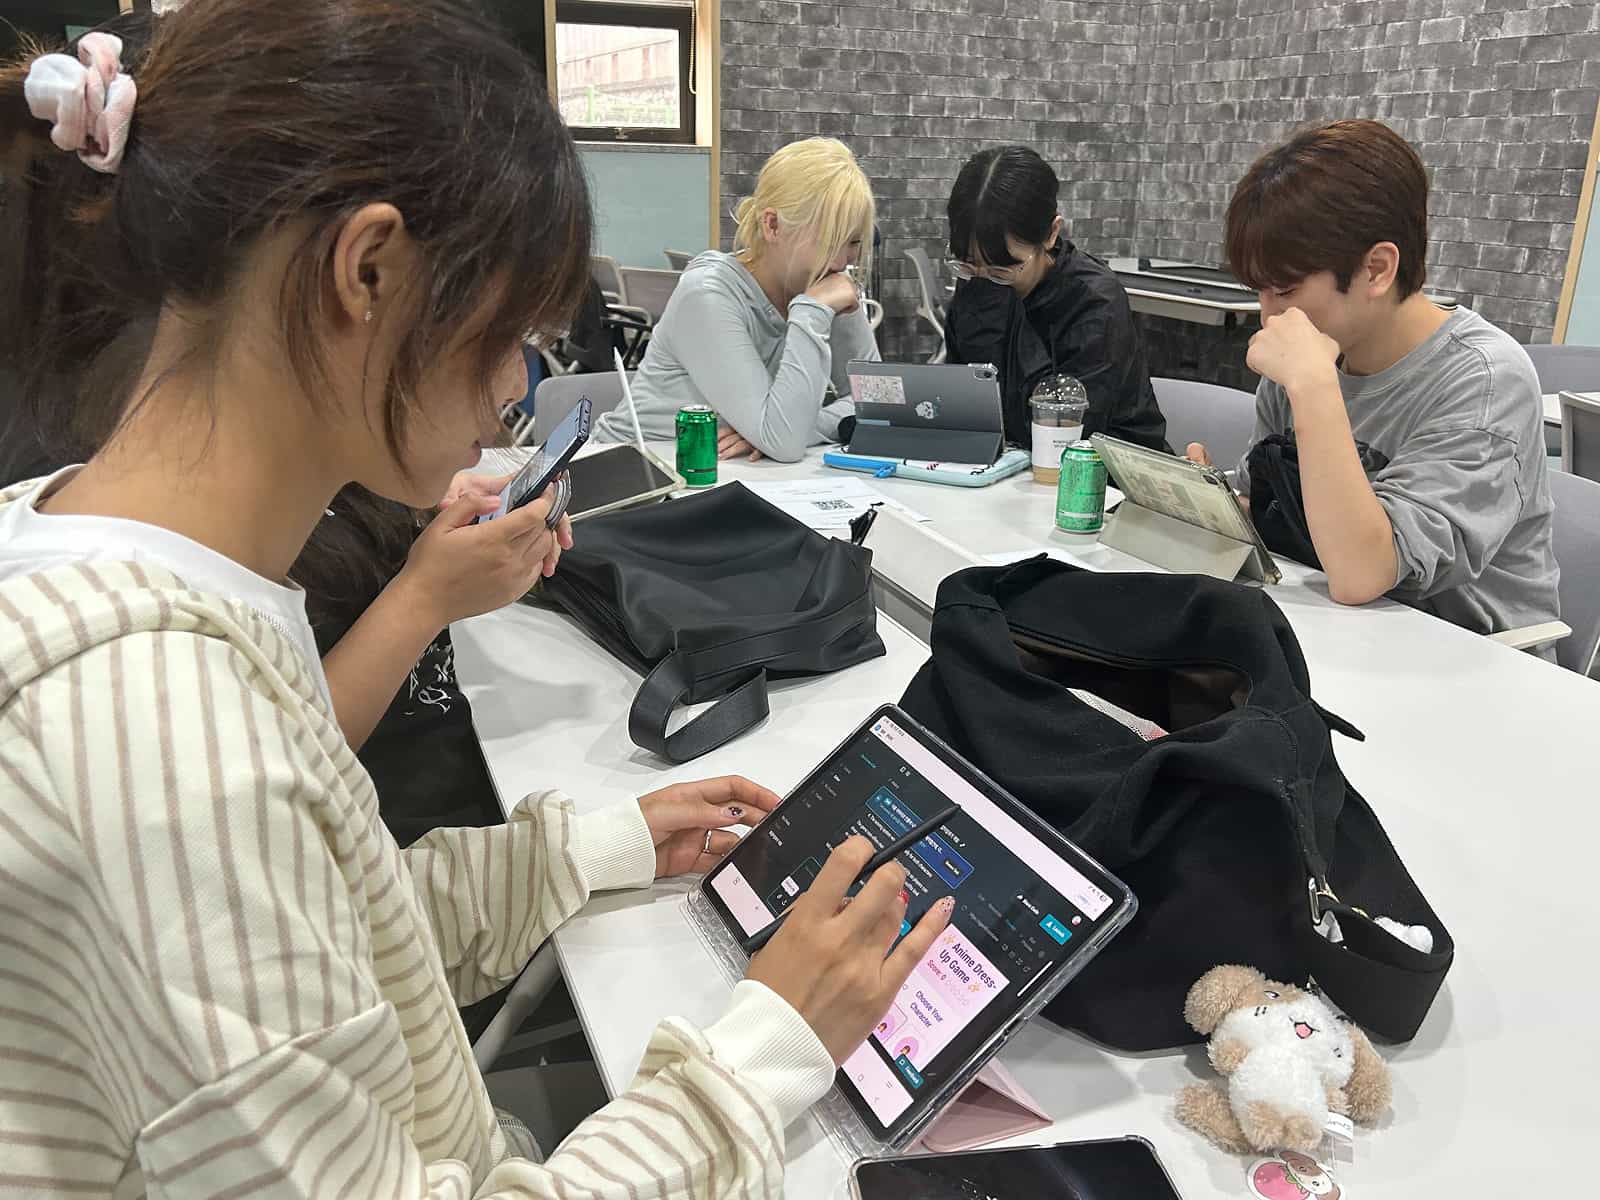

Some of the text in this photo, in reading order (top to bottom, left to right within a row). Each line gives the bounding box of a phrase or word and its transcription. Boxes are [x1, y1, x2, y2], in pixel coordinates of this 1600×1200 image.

[926, 959, 943, 977] Score:
[939, 949, 971, 984] Up Game
[951, 942, 997, 989] Anime Dress-
[909, 1002, 932, 1028] Character
[915, 990, 944, 1023] Choose Your
[904, 1066, 920, 1084] Feedback
